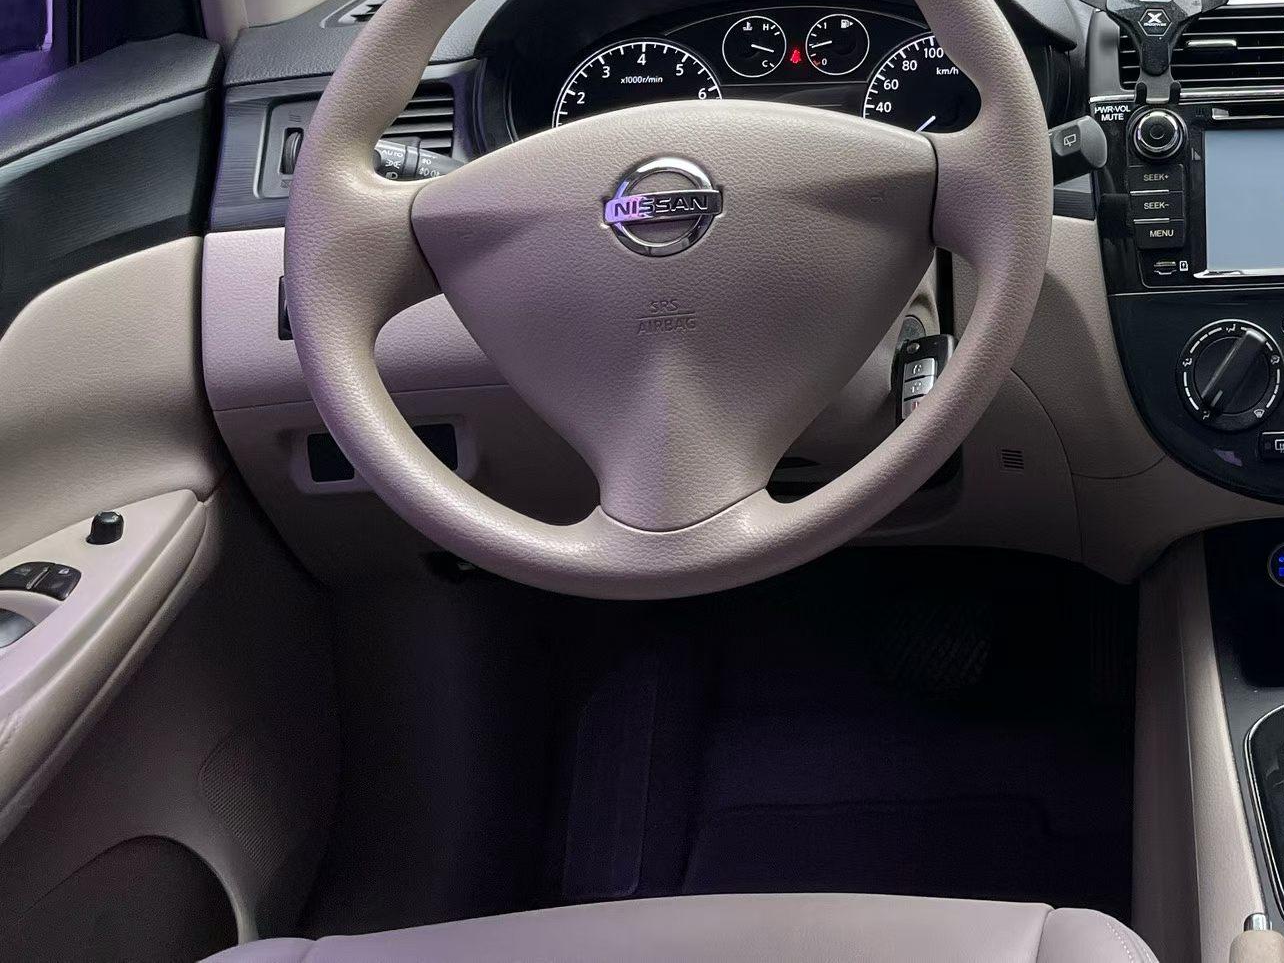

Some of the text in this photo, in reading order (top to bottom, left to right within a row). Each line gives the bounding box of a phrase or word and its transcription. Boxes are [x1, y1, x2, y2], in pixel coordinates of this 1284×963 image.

[637, 53, 646, 65] 4
[924, 47, 944, 59] 100
[821, 58, 828, 66] 0
[902, 59, 918, 71] 80
[602, 66, 611, 78] 3
[676, 64, 684, 76] 5
[936, 66, 959, 75] km/h
[620, 76, 663, 84] x1000r/min
[883, 78, 899, 90] 60
[577, 93, 585, 104] 2
[698, 88, 707, 100] 6
[876, 101, 892, 113] 40
[1101, 112, 1124, 121] MUTE
[381, 149, 404, 158] AUTO
[1143, 173, 1169, 181] SEEK+
[614, 196, 709, 217] NISSAN
[1150, 229, 1174, 237] MENU
[650, 299, 681, 313] SRS
[637, 318, 697, 335] AIRBAG
